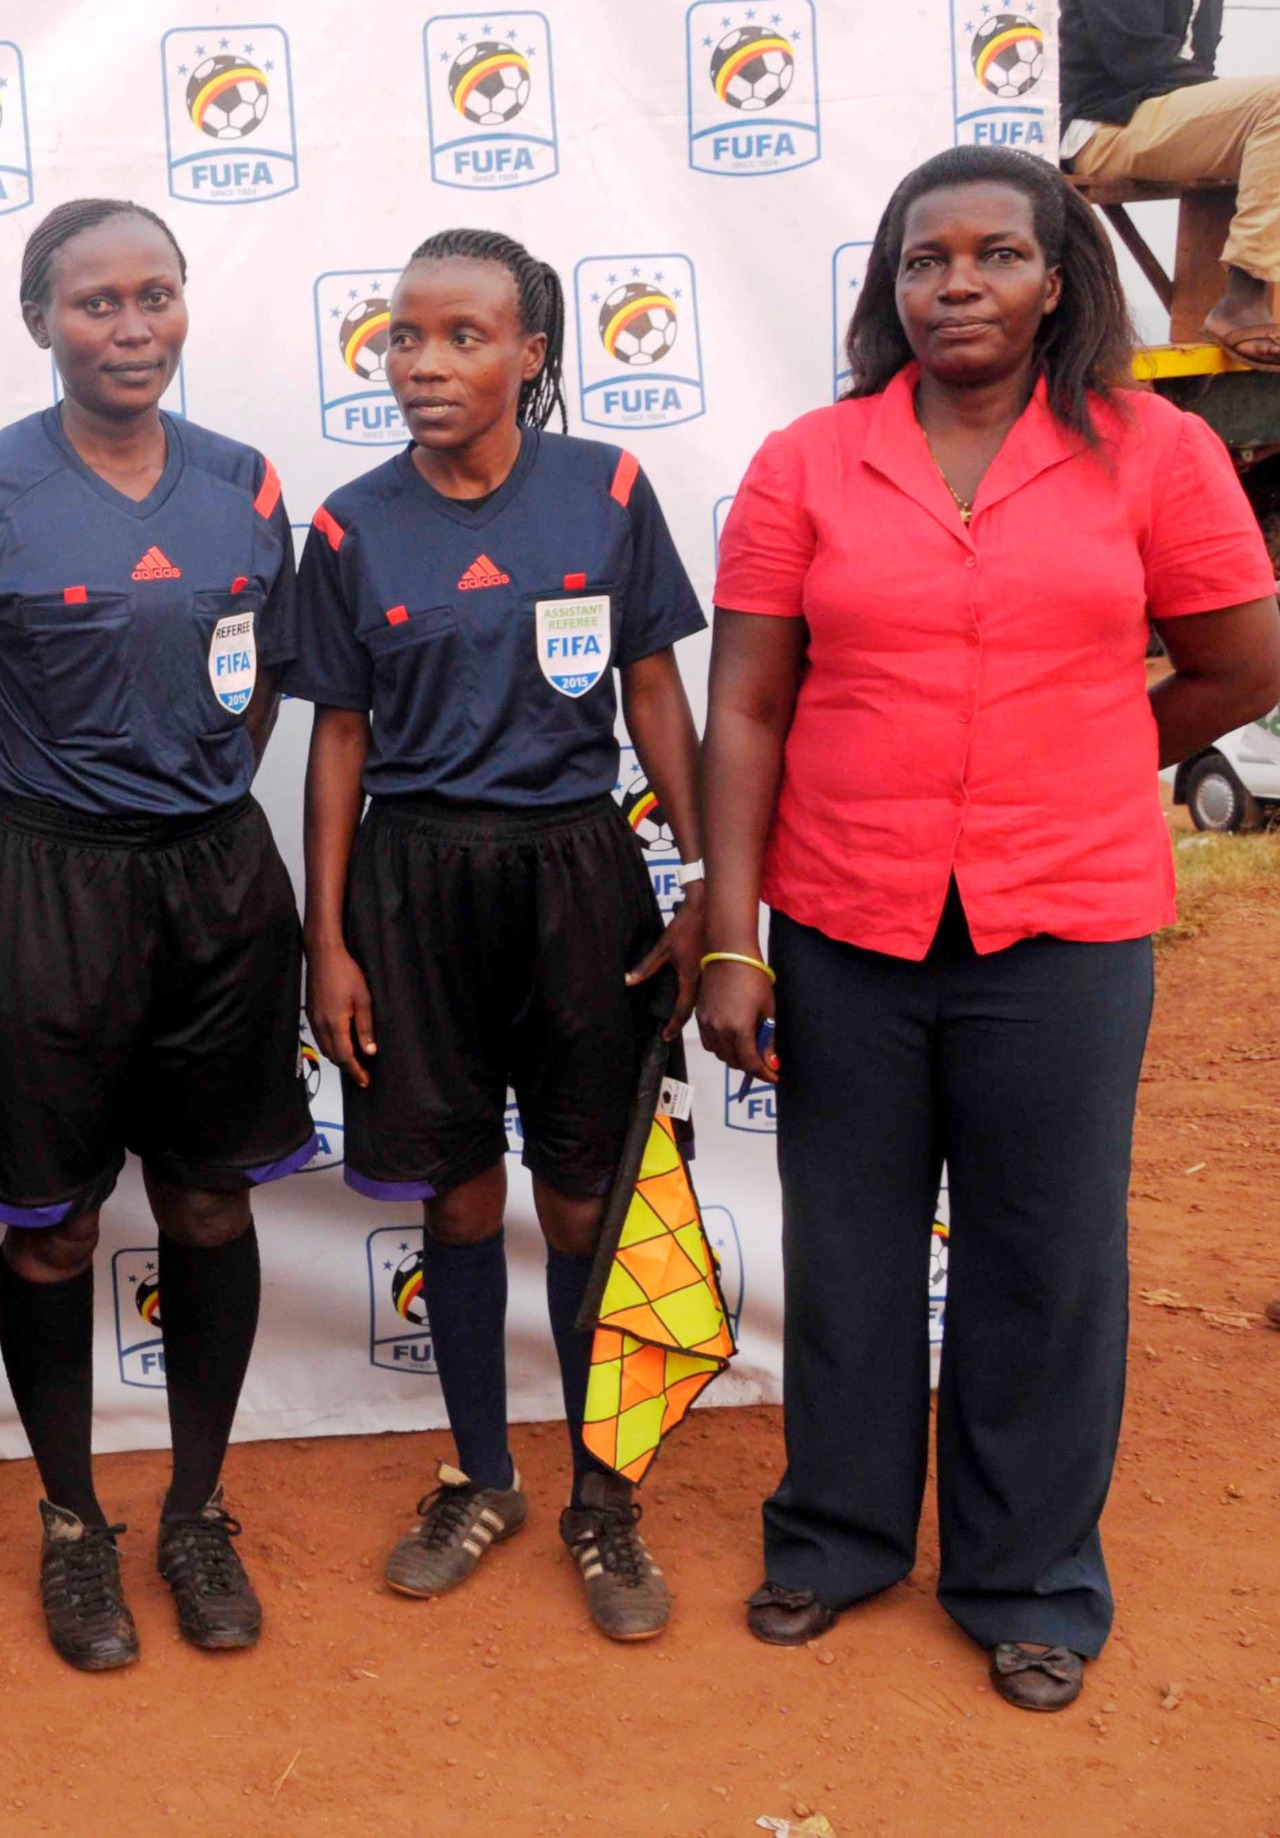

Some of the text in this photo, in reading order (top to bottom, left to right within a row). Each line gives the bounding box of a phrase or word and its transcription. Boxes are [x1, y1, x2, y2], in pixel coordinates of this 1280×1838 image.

[974, 121, 1044, 145] FUFA
[713, 133, 796, 161] FUFA
[454, 147, 535, 175] FUFA
[192, 162, 274, 189] FUFA
[603, 387, 682, 414] FUFA
[345, 405, 408, 430] FUF
[132, 567, 181, 580] adidas
[458, 574, 510, 590] adidas
[544, 605, 603, 618] ASSISTANT
[216, 621, 250, 640] REFEREE
[549, 616, 600, 630] REFEREE
[547, 635, 601, 659] FIFA
[216, 651, 251, 676] FIFA
[561, 676, 589, 689] 2015
[228, 693, 246, 706] 2015
[393, 1345, 431, 1362] FU
